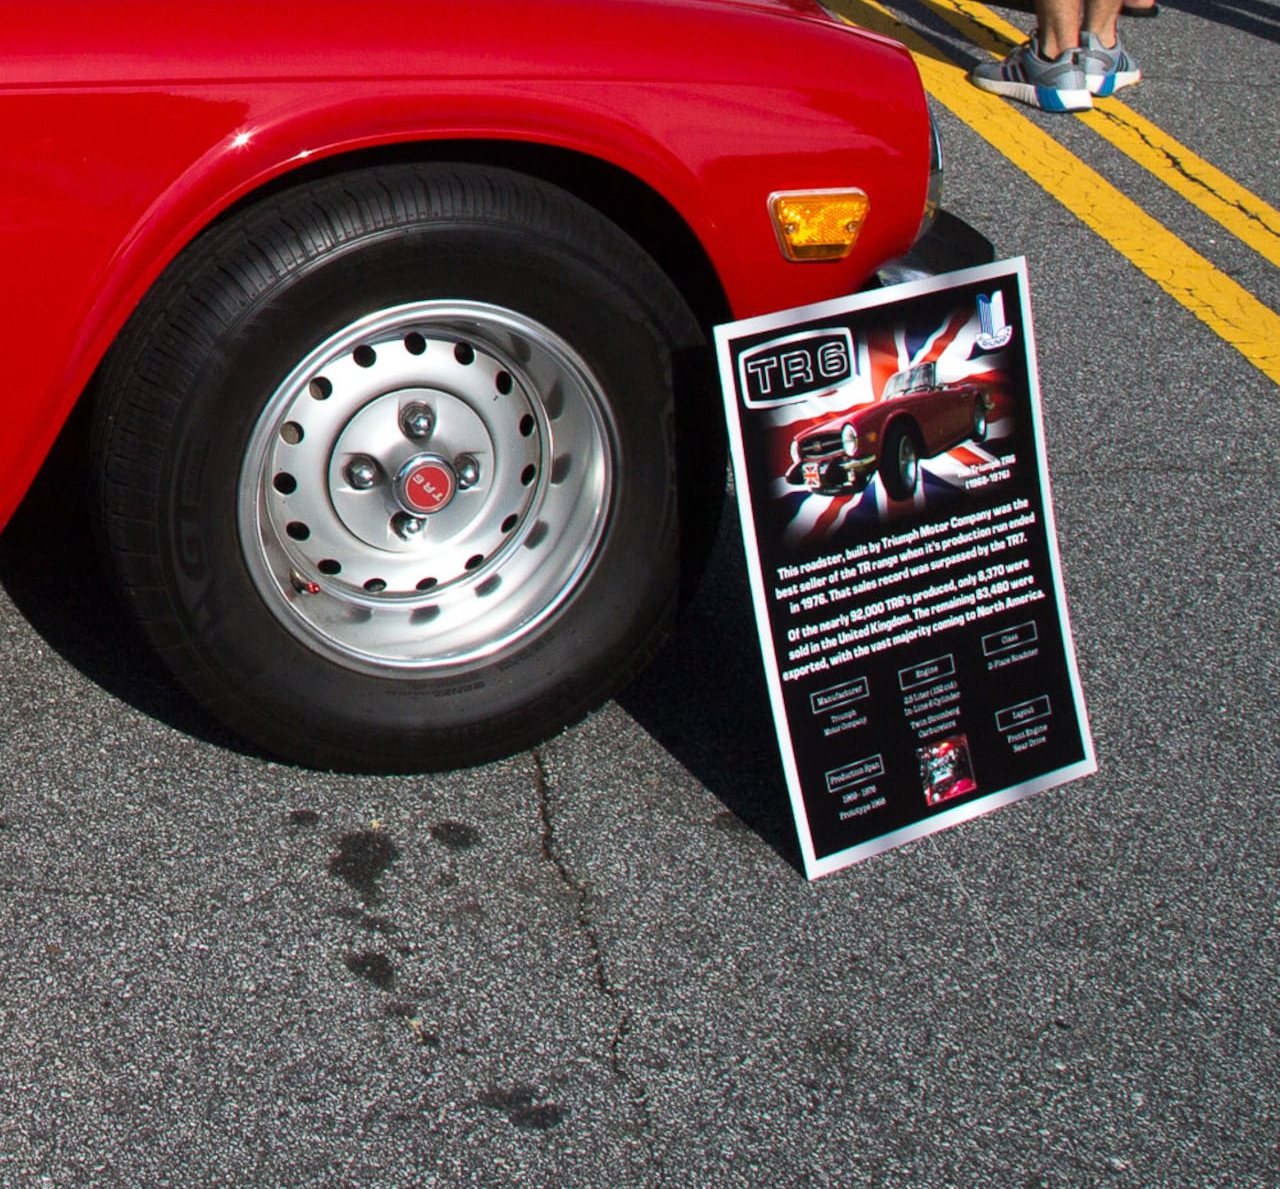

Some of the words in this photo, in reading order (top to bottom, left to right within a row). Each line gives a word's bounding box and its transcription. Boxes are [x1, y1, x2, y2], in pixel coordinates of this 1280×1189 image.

[747, 342, 849, 394] TR6
[412, 473, 444, 502] TR6
[777, 566, 799, 580] This
[800, 554, 845, 574] roadster,
[846, 545, 868, 560] built
[869, 542, 881, 553] by
[881, 529, 919, 549] Triumph
[920, 522, 949, 537] Motor
[950, 510, 991, 528] Company
[993, 504, 1012, 516] was
[1013, 499, 1029, 510] the
[775, 585, 799, 599] best
[799, 577, 827, 592] seller
[828, 571, 839, 583] of
[840, 568, 857, 580] the
[857, 561, 871, 574] TR
[872, 555, 899, 570] range
[899, 547, 924, 561] when
[925, 541, 942, 553] it's
[942, 527, 991, 551] production
[992, 523, 1009, 534] run
[1008, 512, 1035, 529] ended
[790, 602, 800, 613] in
[801, 593, 828, 609] 1976.
[828, 587, 851, 601] That
[852, 580, 877, 594] sales
[878, 567, 909, 587] record
[910, 563, 931, 576] was
[930, 546, 978, 570] surpassed
[977, 545, 989, 556] by
[990, 540, 1006, 552] the
[1006, 532, 1027, 547] TR7.
[788, 628, 800, 641] Of
[802, 625, 818, 637] the
[819, 614, 849, 632] nearly
[850, 602, 885, 622] 92,000
[885, 595, 913, 610] TR6's
[912, 580, 957, 604] produced,
[958, 574, 977, 588] only
[978, 564, 1005, 581] 8,370
[1006, 559, 1030, 573] were
[789, 644, 810, 660] sold
[810, 642, 820, 653] in
[821, 637, 838, 650] the
[838, 625, 870, 644] United
[870, 614, 913, 634] Kingdom.
[912, 608, 930, 620] The
[931, 593, 976, 614] remaining
[976, 581, 1009, 600] 83,480
[1010, 575, 1034, 589] were
[783, 657, 830, 681] exported,
[829, 650, 853, 665] with
[853, 646, 871, 658] the
[870, 638, 892, 652] vast
[892, 625, 931, 645] majority
[932, 615, 965, 632] coming
[965, 611, 976, 621] to
[976, 601, 1005, 618] North
[1006, 590, 1045, 608] America.
[916, 666, 938, 678] Engine
[817, 686, 862, 705] Manufacturer
[842, 717, 867, 730] Company
[1012, 707, 1034, 719] Layout
[1025, 725, 1047, 736] Engine
[829, 766, 866, 785] Production
[839, 804, 871, 820] Prototype
